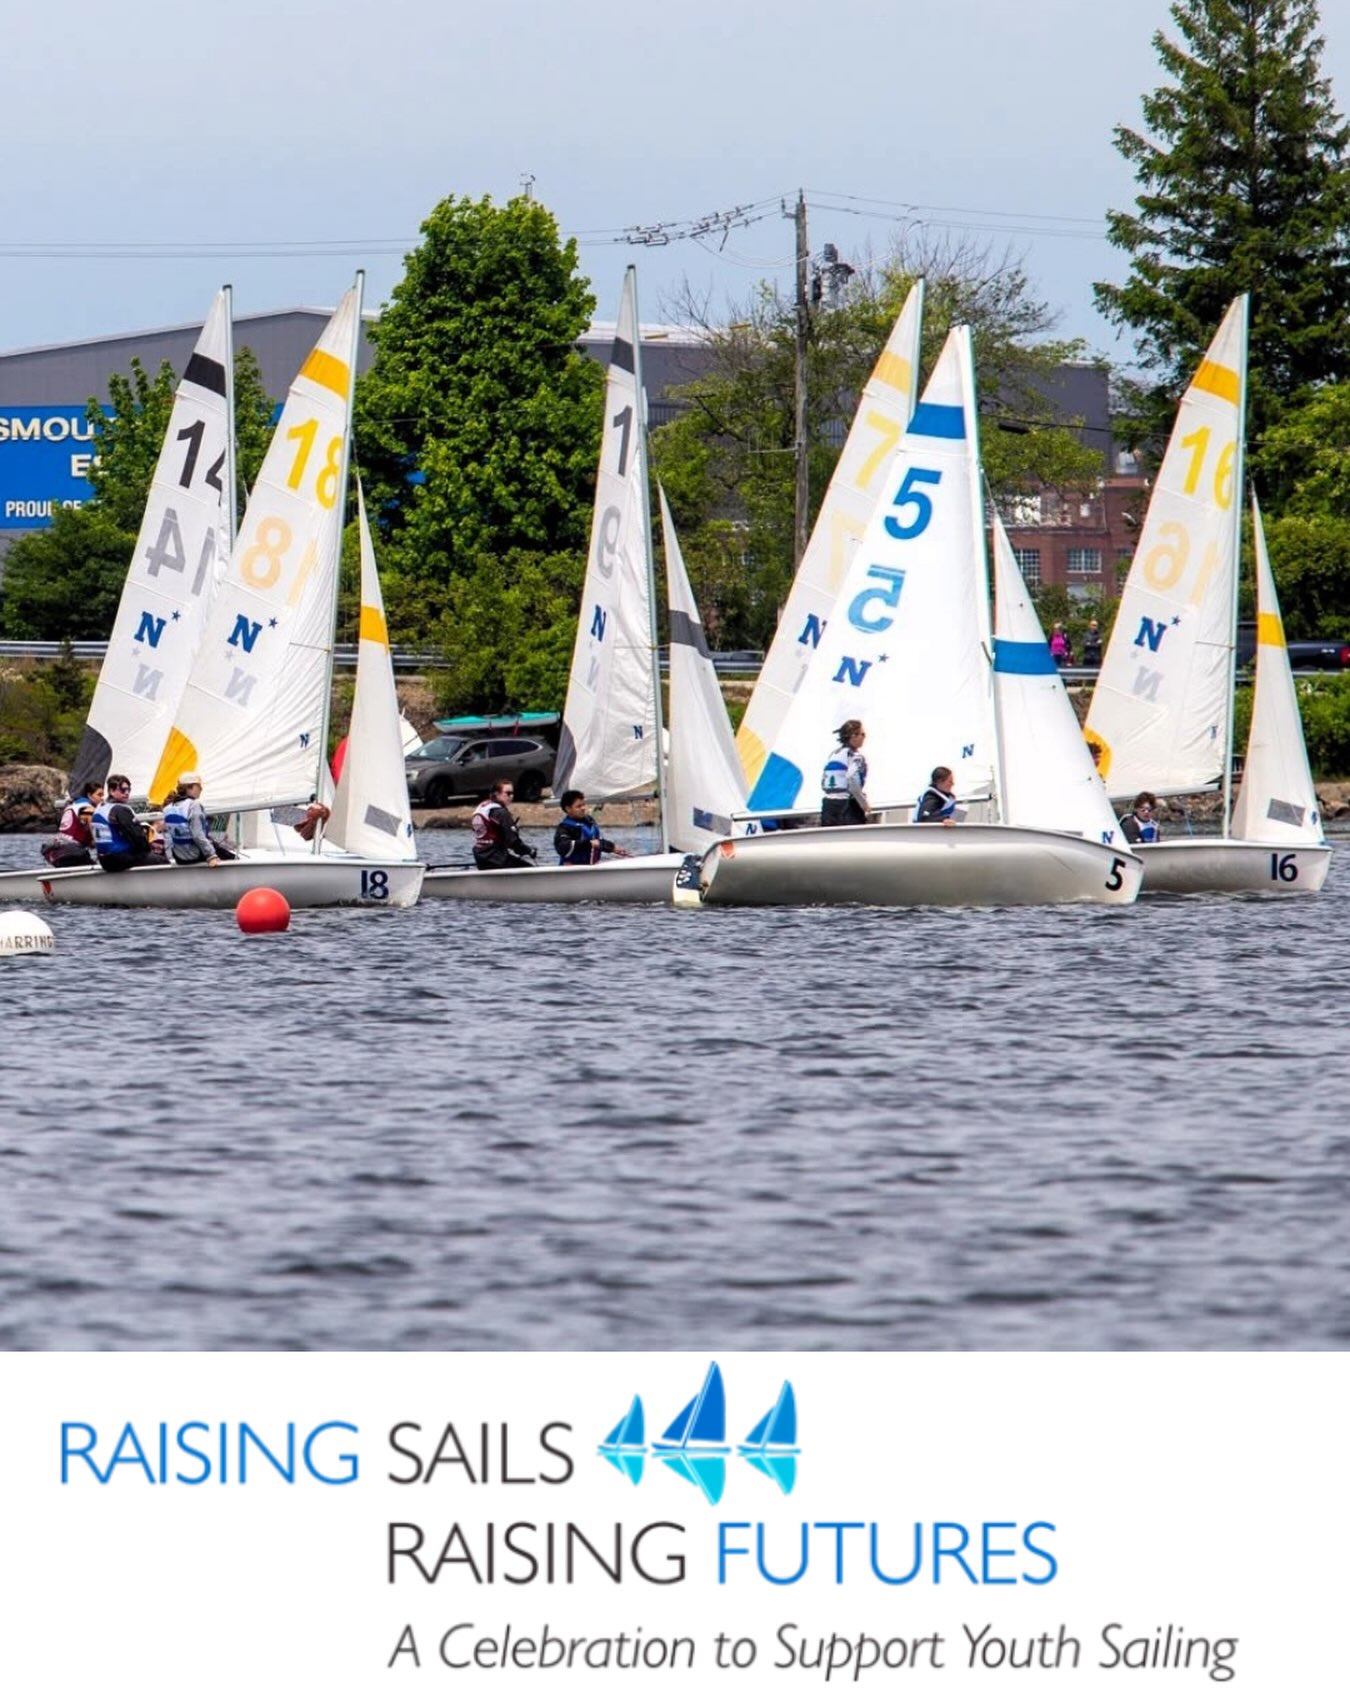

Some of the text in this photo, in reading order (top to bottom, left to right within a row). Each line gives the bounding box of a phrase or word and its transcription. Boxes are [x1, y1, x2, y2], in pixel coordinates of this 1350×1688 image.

[0, 416, 117, 441] SMOU
[286, 417, 344, 511] 18
[854, 408, 902, 492] 7
[1180, 425, 1237, 511] 16
[884, 467, 942, 540] 5
[134, 611, 167, 649] N
[227, 613, 263, 654] N
[591, 603, 607, 643] N
[798, 613, 828, 650] N
[1134, 615, 1167, 652] N
[832, 656, 873, 688] N
[633, 725, 643, 739] N
[962, 743, 975, 759] N
[1102, 831, 1114, 845] N
[361, 869, 389, 900] 18
[1105, 857, 1126, 891] 5
[1270, 853, 1298, 882] 16
